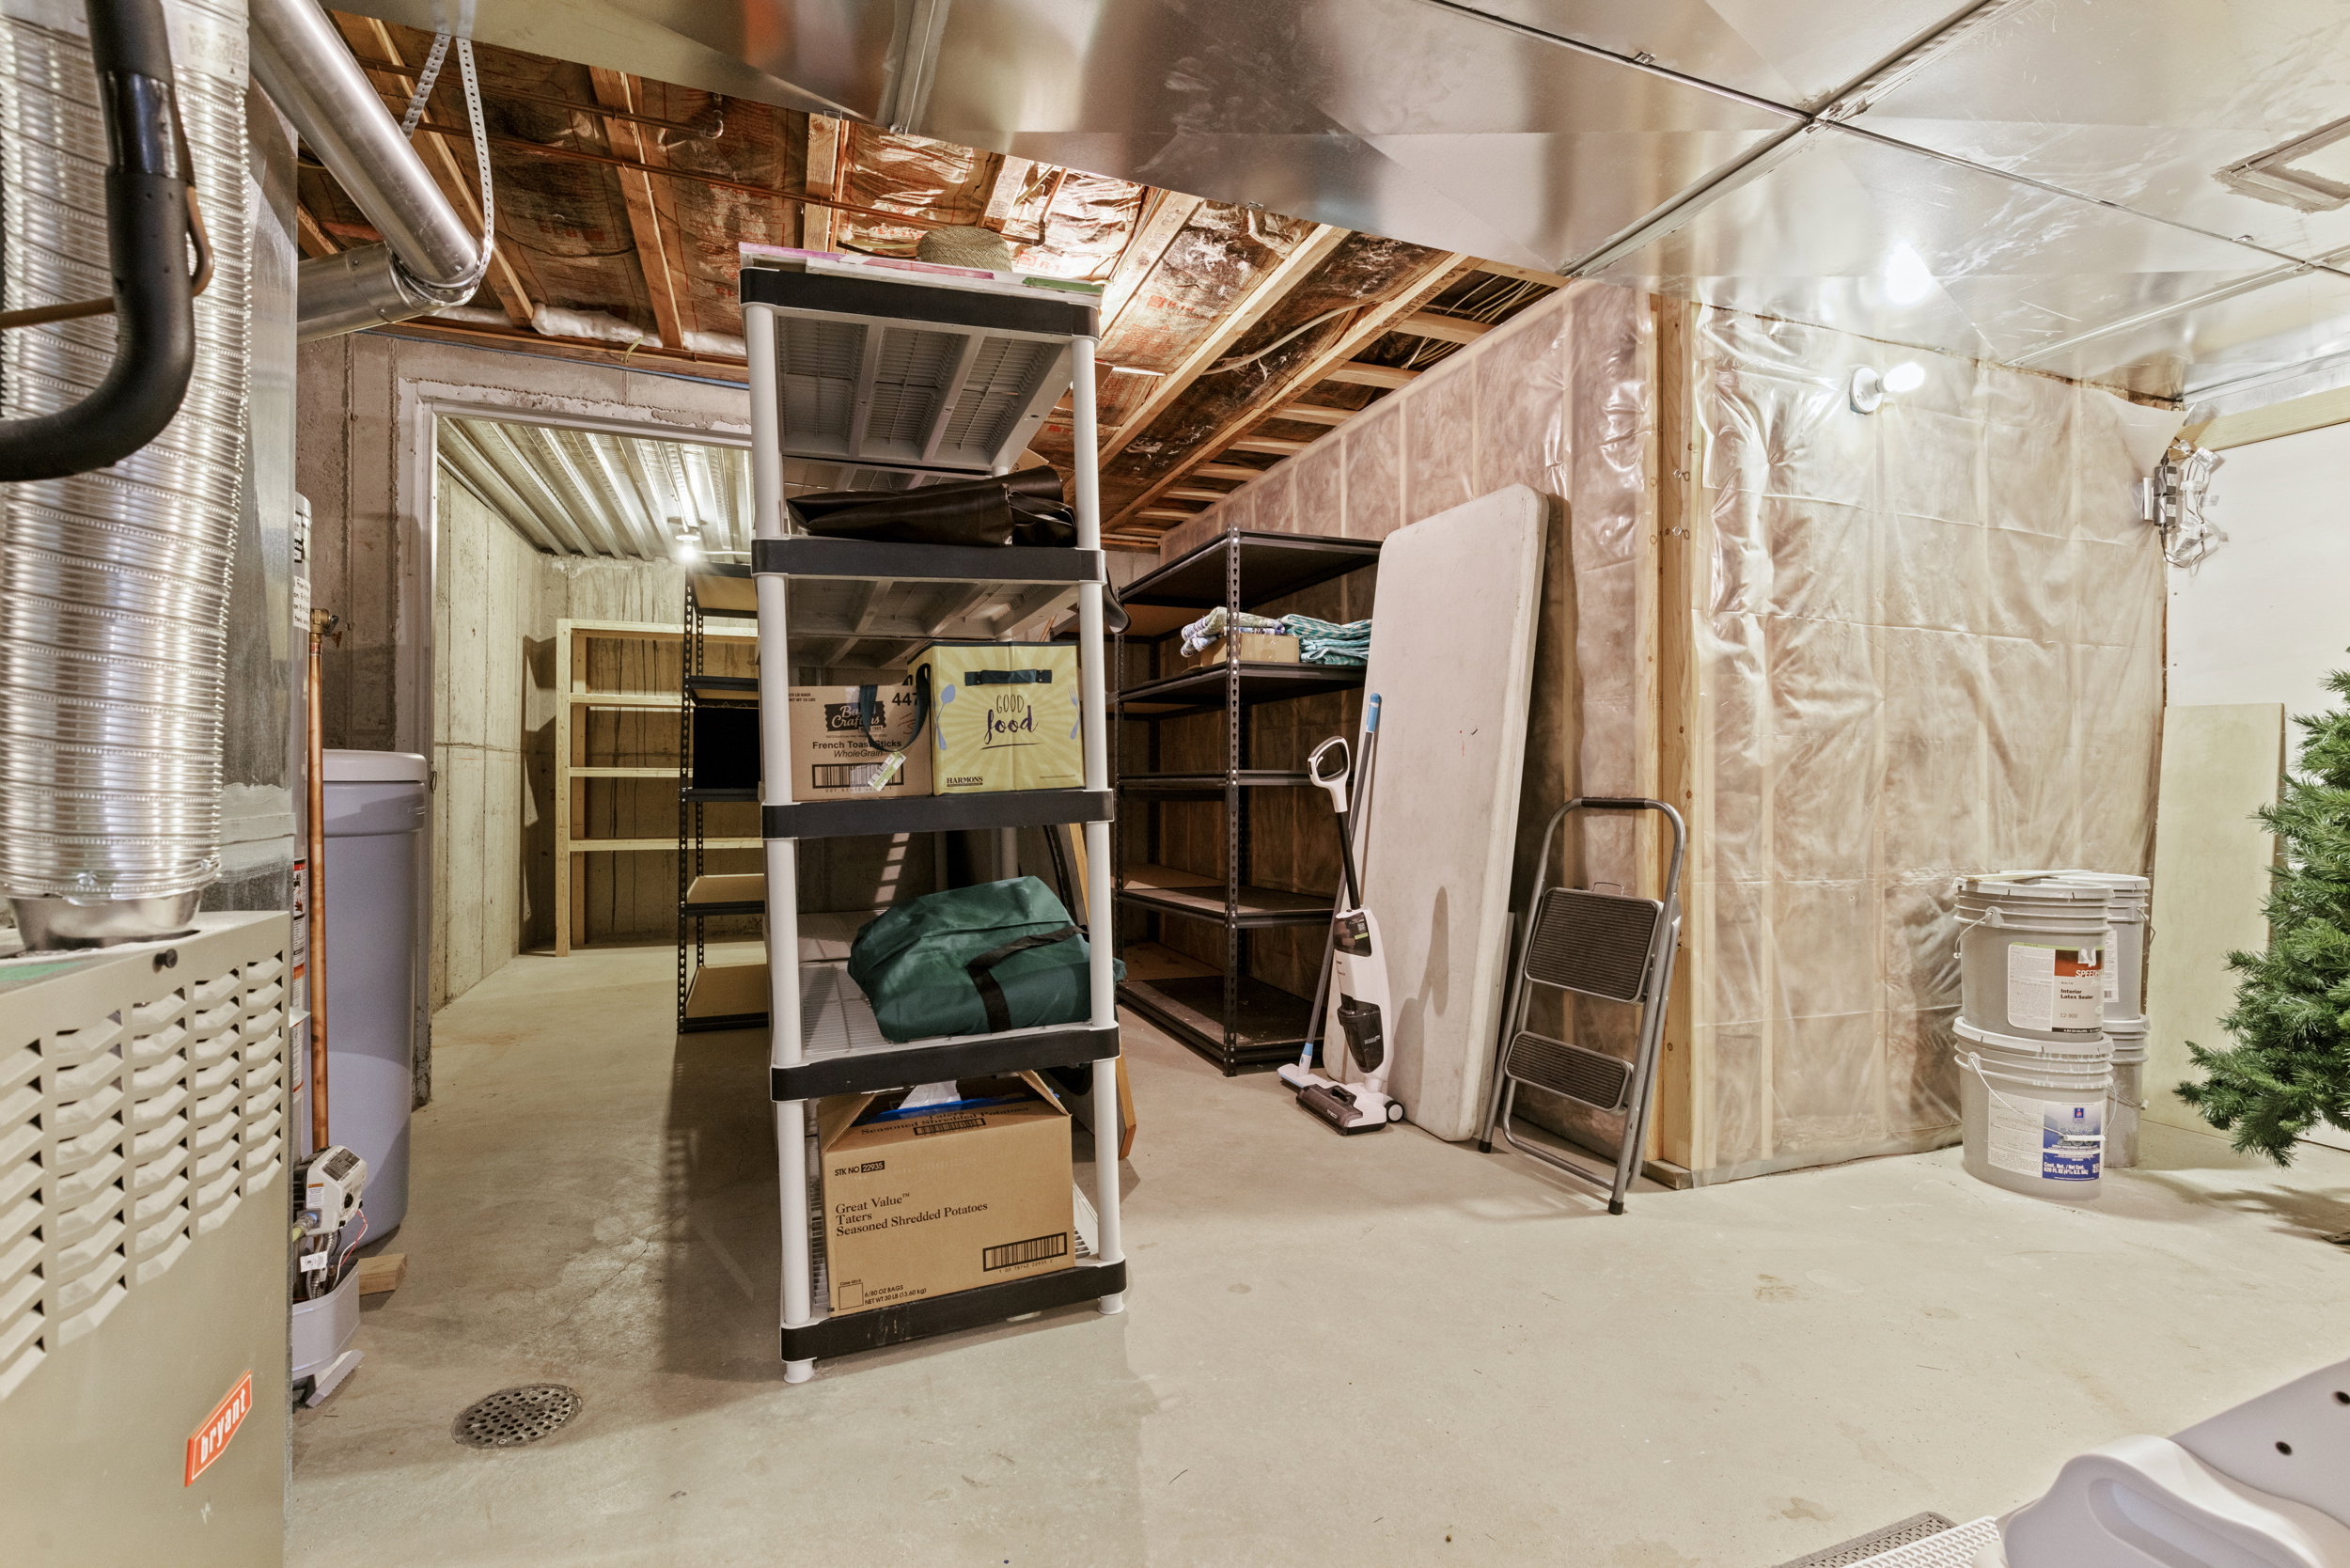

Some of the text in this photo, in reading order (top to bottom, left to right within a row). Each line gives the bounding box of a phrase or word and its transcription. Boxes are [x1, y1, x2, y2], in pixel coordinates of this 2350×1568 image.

[996, 694, 1024, 713] GOOD
[984, 705, 1039, 745] food
[812, 741, 845, 749] French
[875, 739, 902, 747] Sticks
[834, 749, 884, 758] WholeGrain
[861, 1121, 918, 1136] Seasoned
[921, 1113, 977, 1126] Shredded
[979, 1106, 1029, 1118] Potatoes
[835, 1162, 884, 1176] STK NO 22935
[835, 1201, 868, 1215] Great
[836, 1212, 872, 1225] Taters
[837, 1202, 988, 1237] Seasoned Shredded Potatoes
[900, 1290, 916, 1298] (13.60
[200, 1388, 245, 1465] bryant
